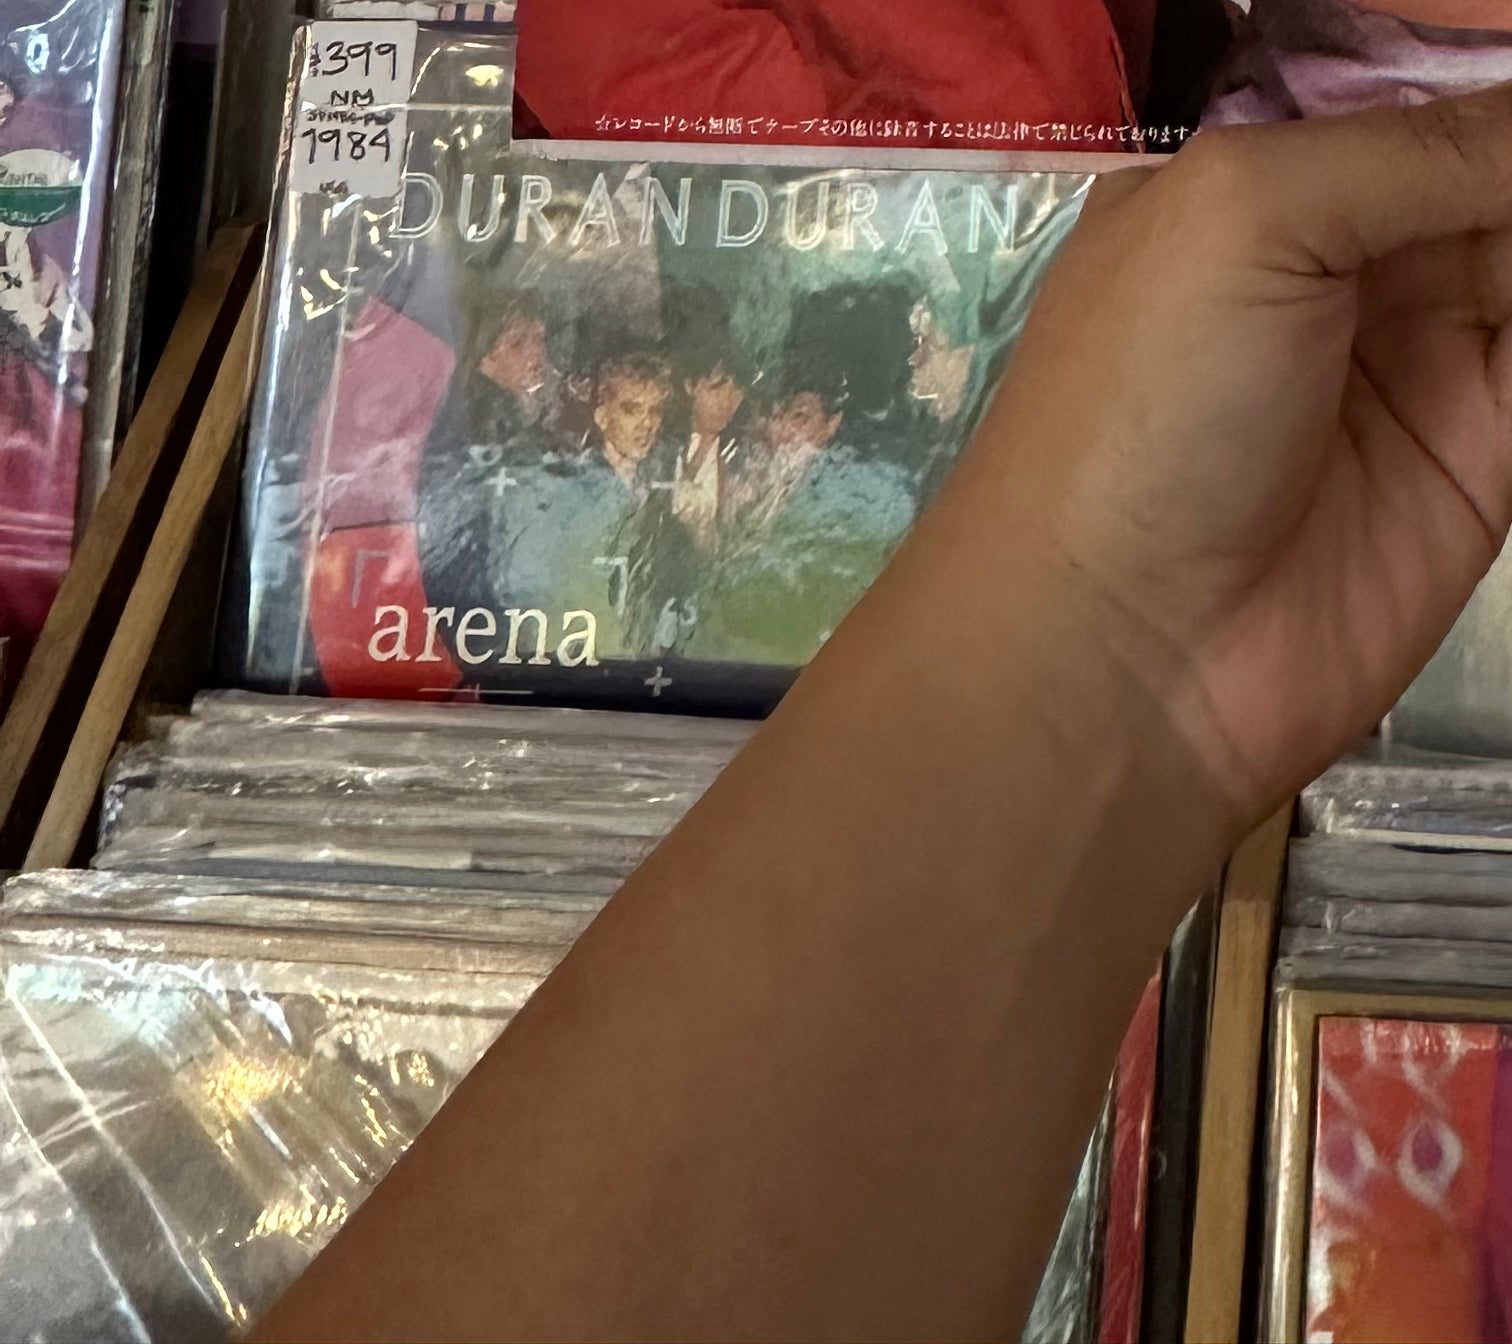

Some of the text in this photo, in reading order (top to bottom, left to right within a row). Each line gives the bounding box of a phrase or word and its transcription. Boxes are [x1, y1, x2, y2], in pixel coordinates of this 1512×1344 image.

[308, 40, 398, 82] $399
[301, 127, 391, 165] 1984
[388, 170, 1020, 255] DURAN DURAN
[367, 601, 601, 668] arena
